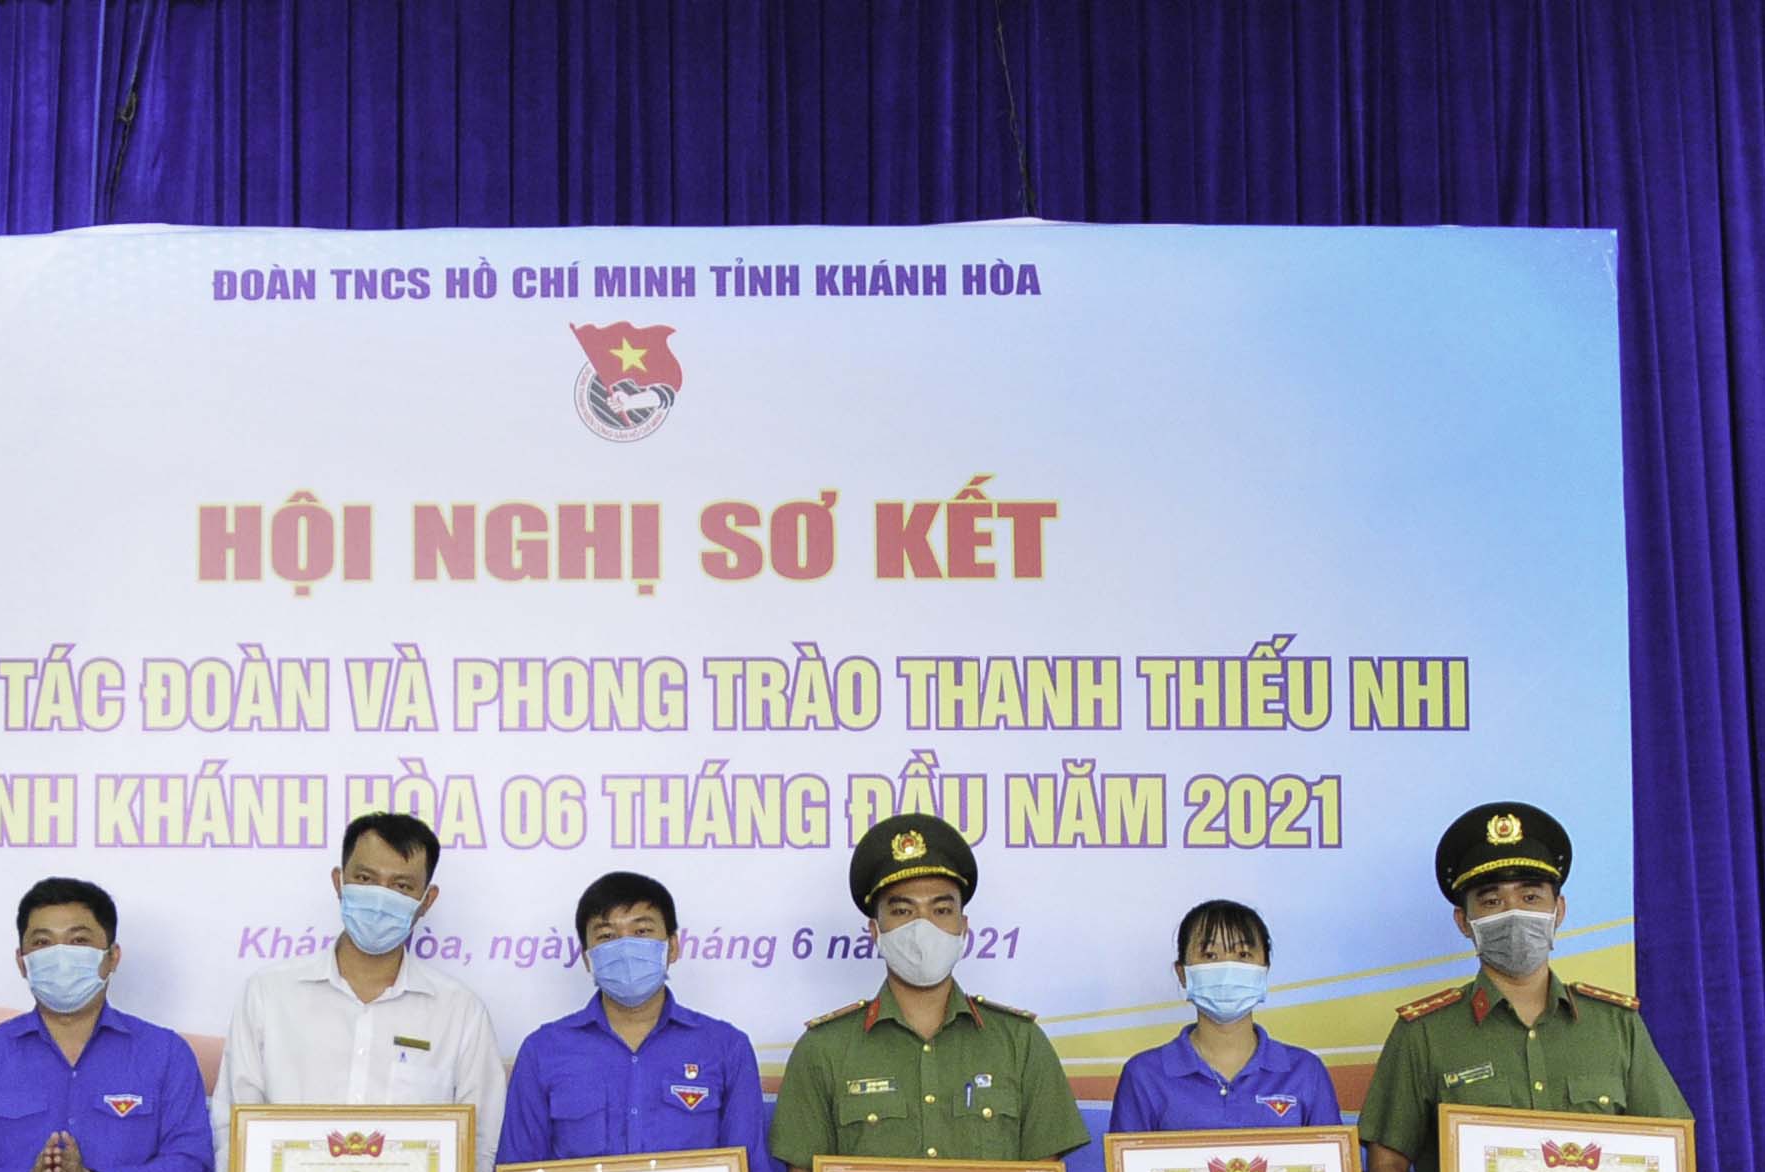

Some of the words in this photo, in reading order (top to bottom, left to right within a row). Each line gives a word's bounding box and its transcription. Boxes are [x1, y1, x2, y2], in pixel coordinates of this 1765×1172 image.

[212, 259, 316, 303] ĐOÀN
[330, 267, 431, 302] TNCS
[445, 256, 498, 300] HỒ
[512, 260, 580, 301] CHÍ
[594, 265, 697, 299] MINH
[709, 257, 801, 298] TỈNH
[815, 259, 947, 298] KHÁNH
[962, 258, 1042, 298] HÒA
[196, 488, 374, 598] HỘI
[411, 499, 664, 598] NGHỊ
[698, 486, 842, 585] SƠ
[873, 471, 1062, 583] KẾT
[139, 642, 330, 733] ĐOÀN
[344, 642, 440, 733] VÀ
[453, 656, 690, 734] PHONG
[702, 640, 883, 733] TRÀO
[895, 655, 1124, 732] THANH
[1135, 633, 1334, 733] THIẾU
[1347, 656, 1471, 733] NHI
[94, 759, 329, 850] KHÁNH
[500, 774, 588, 852] 06
[601, 758, 831, 851] THÁNG
[1004, 758, 1170, 849] NĂM
[1183, 773, 1344, 850] 2021
[678, 927, 777, 968] háng
[792, 927, 814, 960] 6
[827, 927, 884, 959] nă
